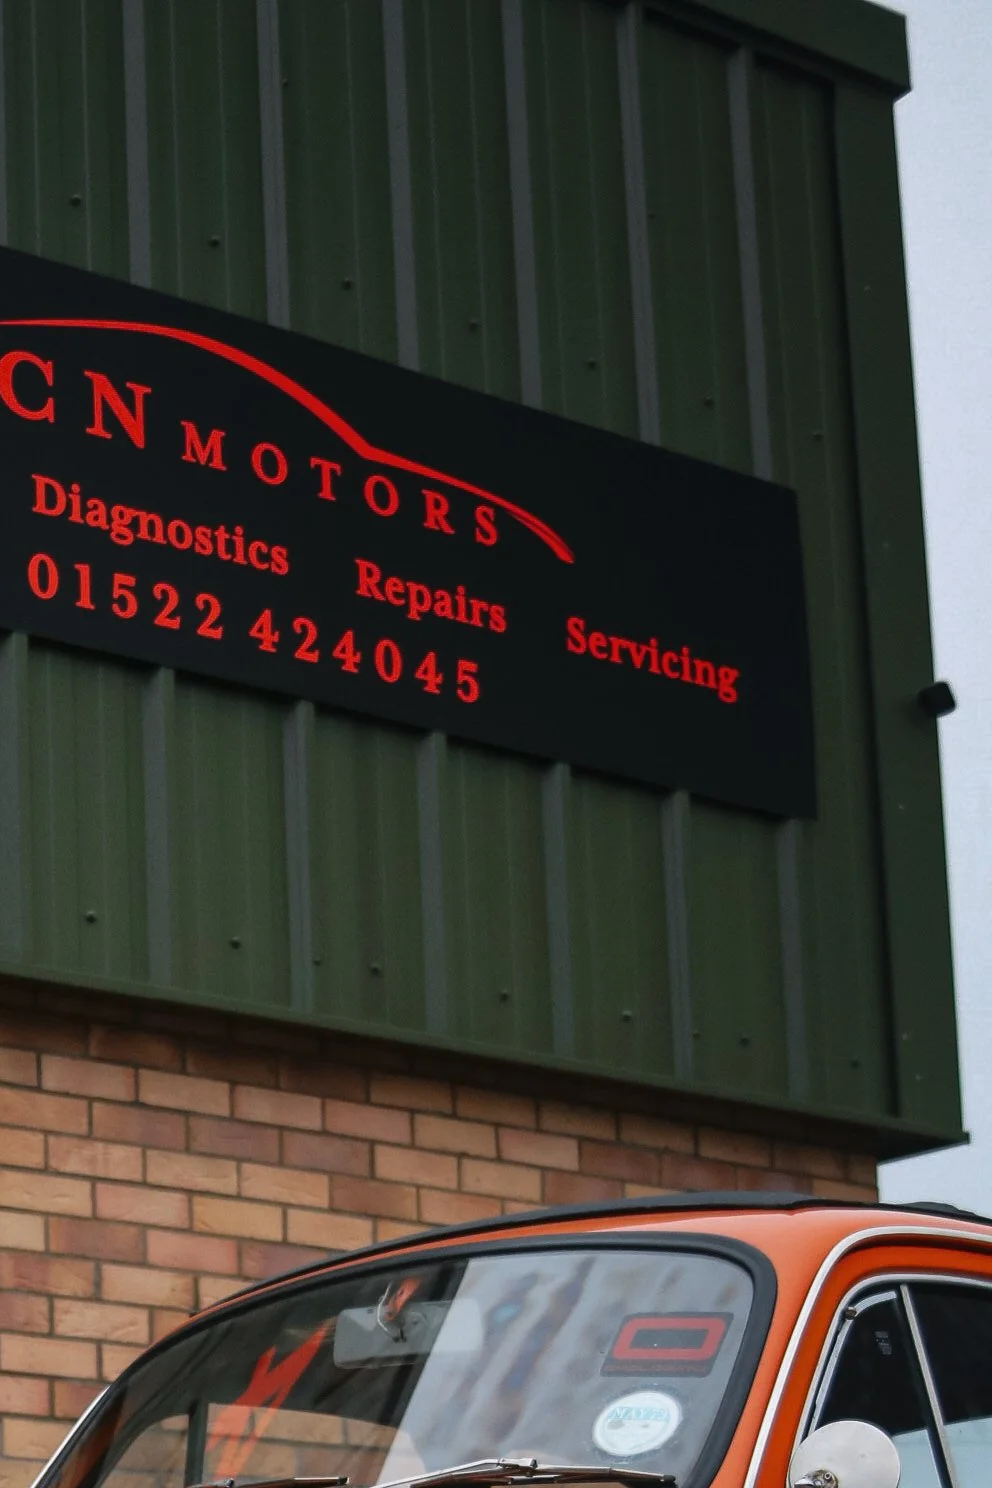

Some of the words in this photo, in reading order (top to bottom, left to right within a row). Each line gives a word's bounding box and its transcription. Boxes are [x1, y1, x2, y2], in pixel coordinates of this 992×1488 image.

[181, 420, 498, 546] MOTORS
[27, 552, 223, 640] 01522
[249, 608, 481, 703] 424045
[31, 473, 290, 575] Diagnostics
[355, 559, 508, 633] Repairs
[566, 616, 740, 703] Servicing
